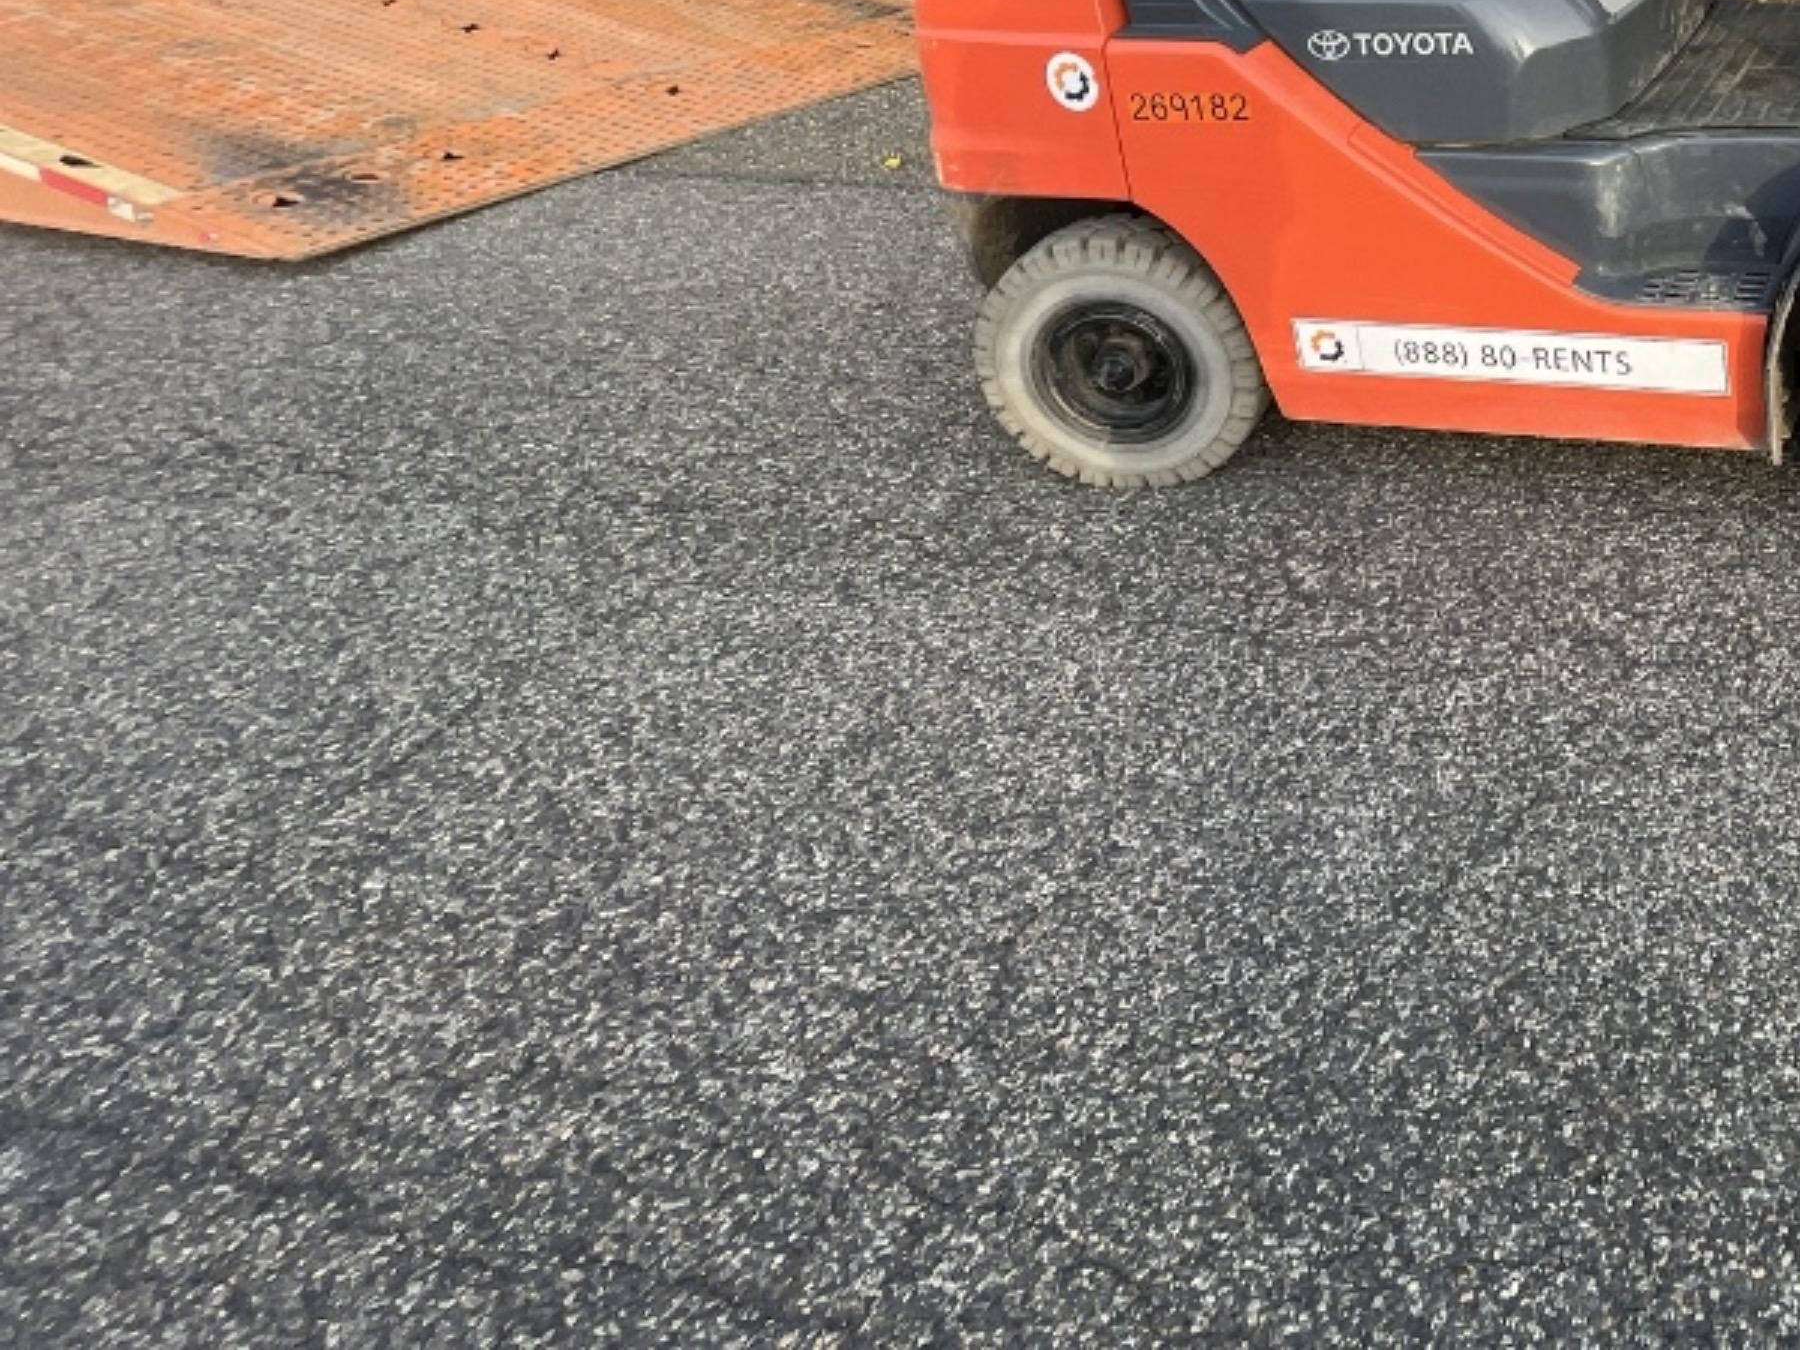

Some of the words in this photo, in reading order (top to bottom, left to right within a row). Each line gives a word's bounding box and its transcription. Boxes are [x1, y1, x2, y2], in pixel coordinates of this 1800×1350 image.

[1352, 32, 1474, 56] TOYOTA
[1129, 92, 1250, 121] 269182
[1394, 337, 1468, 369] (888)
[1480, 344, 1633, 377] 80-RENTS
